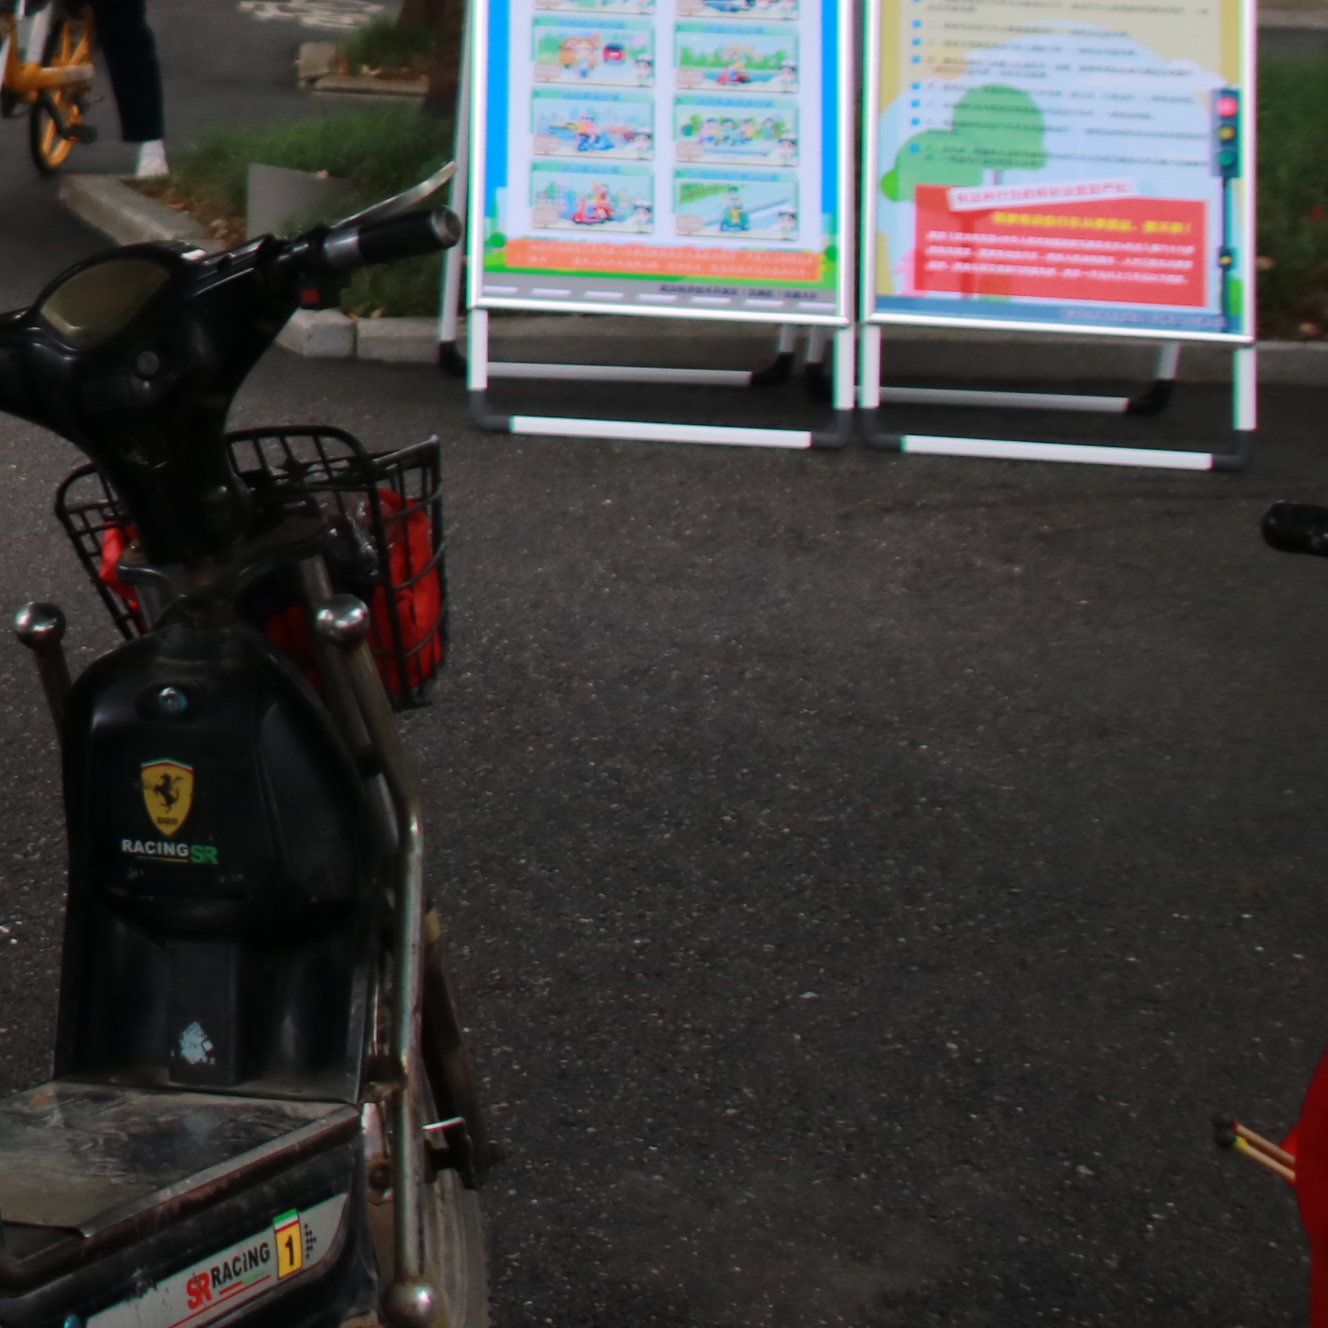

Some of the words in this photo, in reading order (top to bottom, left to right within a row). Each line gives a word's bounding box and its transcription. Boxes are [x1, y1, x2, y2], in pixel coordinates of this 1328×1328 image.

[120, 838, 190, 857] RACING
[189, 843, 220, 866] SR
[186, 1271, 213, 1310] SR
[210, 1241, 271, 1288] RACING
[285, 1234, 295, 1266] 1
